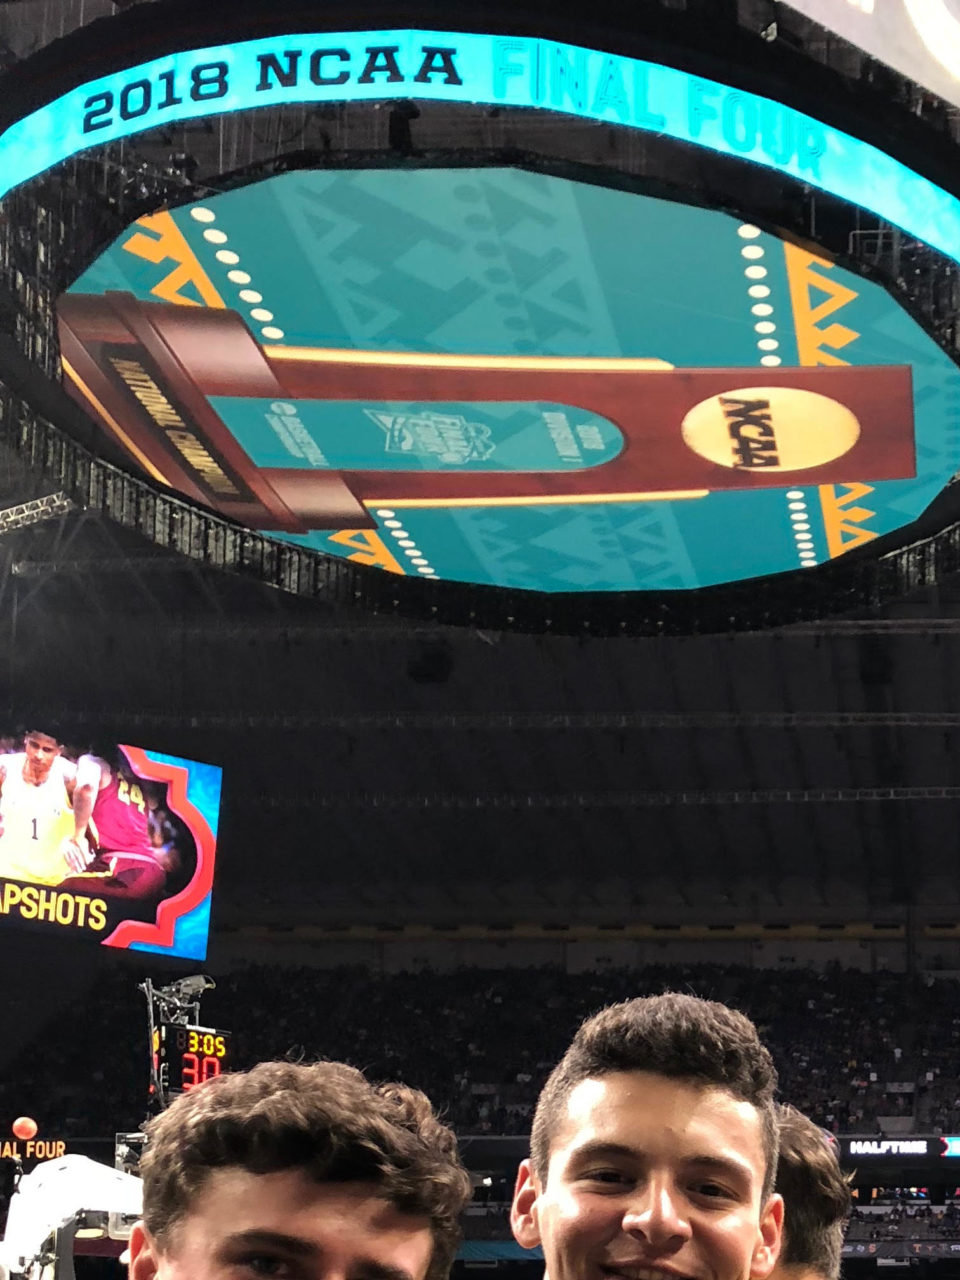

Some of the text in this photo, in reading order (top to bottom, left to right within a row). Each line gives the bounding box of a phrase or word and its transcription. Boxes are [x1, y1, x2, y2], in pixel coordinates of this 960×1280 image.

[83, 39, 827, 181] 2018 NCAA FINAL FOUR
[718, 396, 781, 469] NCAA
[0, 883, 108, 931] PSHOTS
[189, 1031, 226, 1057] 3:05
[182, 1053, 220, 1091] 30
[0, 1141, 66, 1159] AL FOUR
